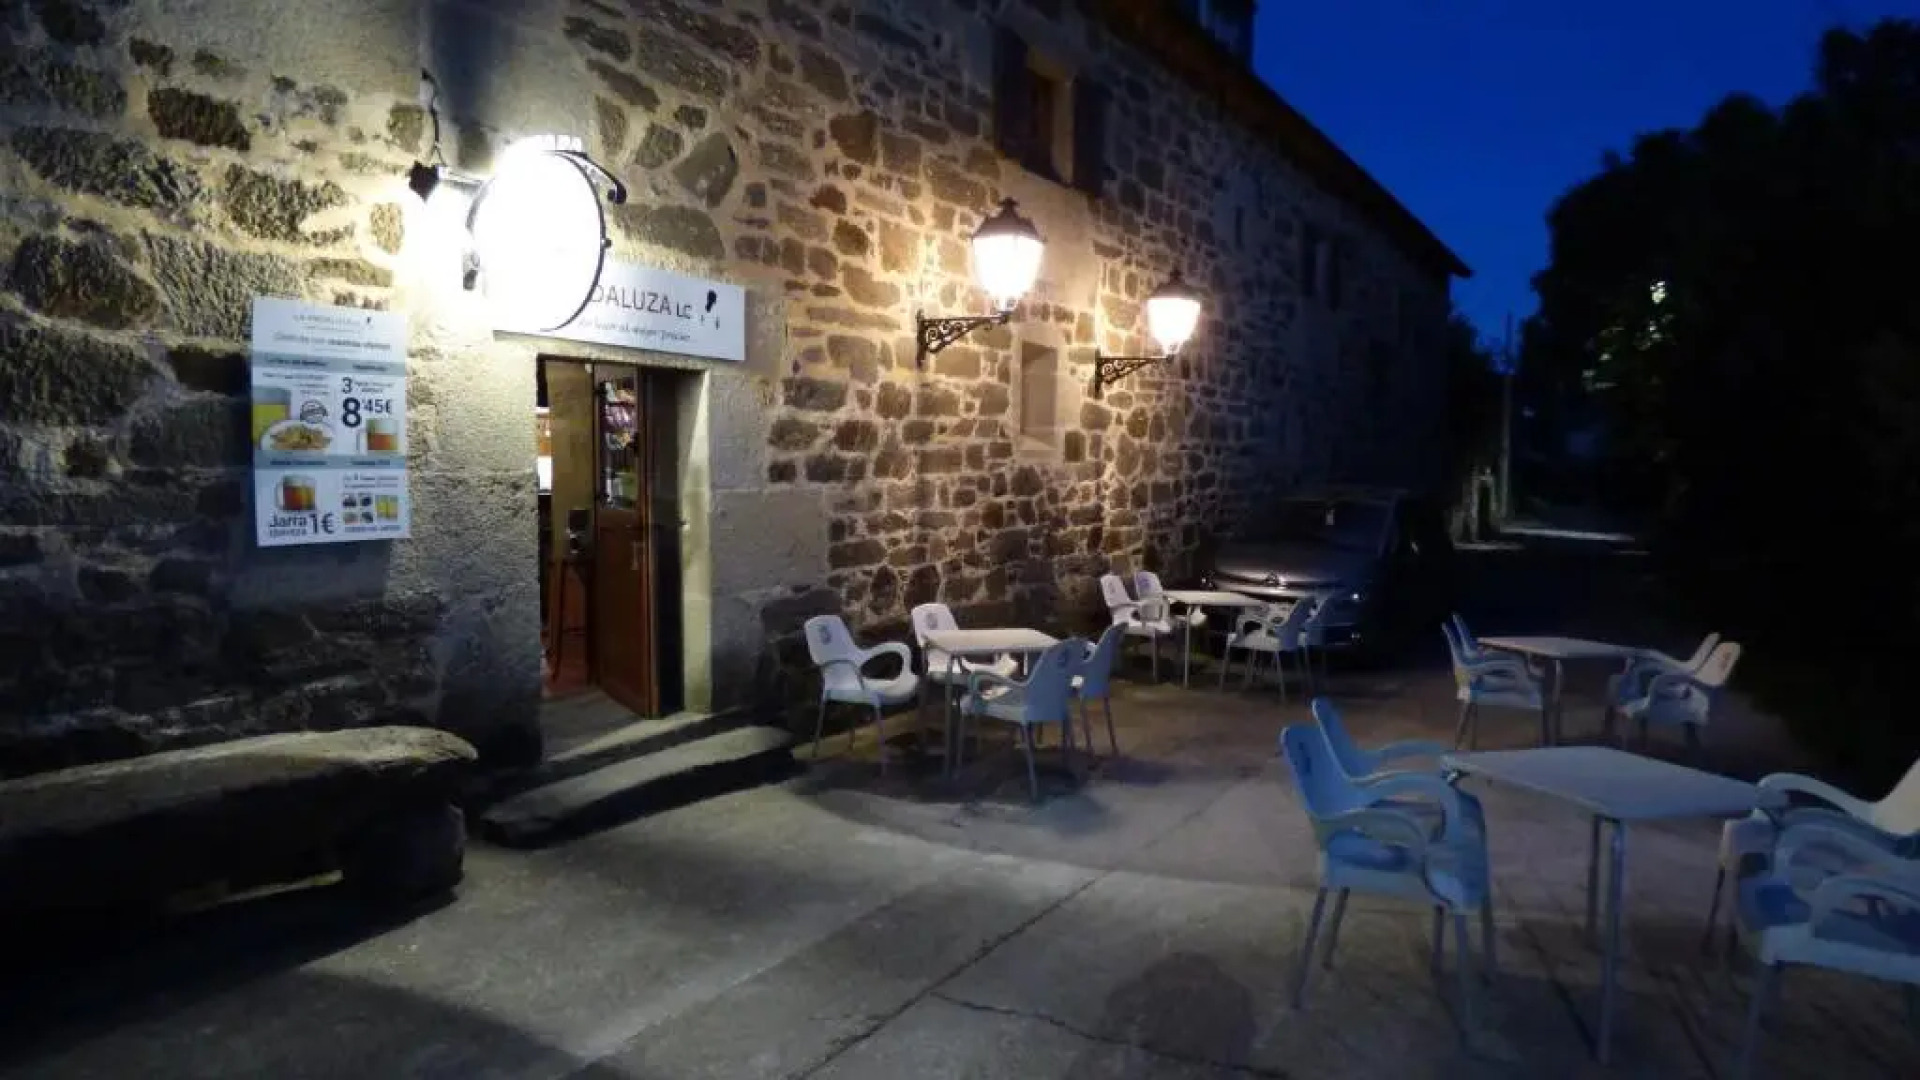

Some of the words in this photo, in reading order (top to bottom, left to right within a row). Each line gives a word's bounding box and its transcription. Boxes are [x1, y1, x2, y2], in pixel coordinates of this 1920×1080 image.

[341, 376, 354, 394] 3
[269, 512, 308, 528] Jarra
[309, 511, 335, 535] 1€
